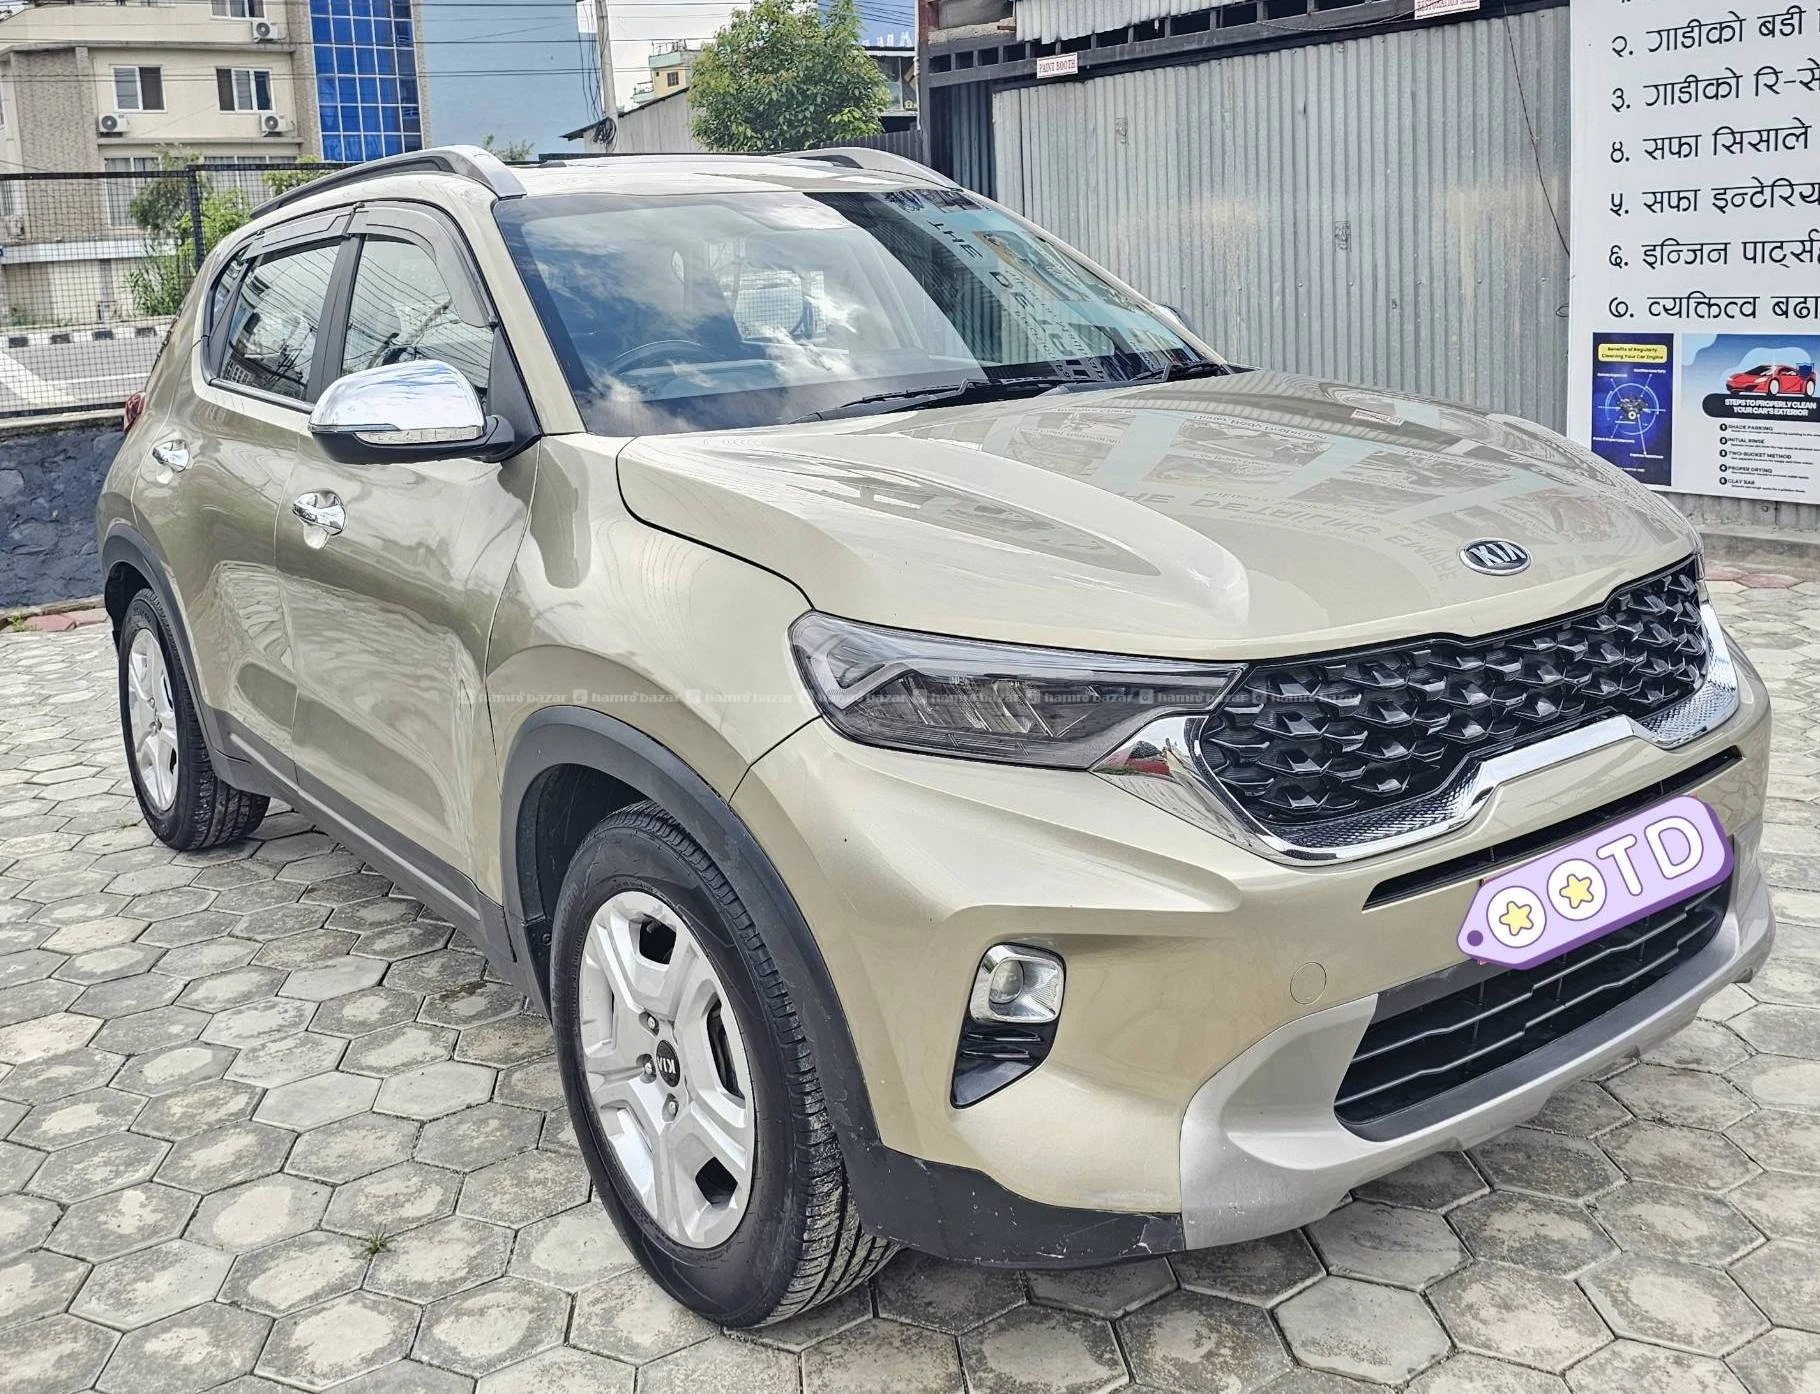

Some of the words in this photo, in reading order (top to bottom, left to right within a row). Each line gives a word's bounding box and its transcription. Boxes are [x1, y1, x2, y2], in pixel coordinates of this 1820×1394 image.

[1646, 11, 1746, 52] गाडीको
[1757, 5, 1806, 38] बडी
[1040, 62, 1055, 73] PAINT
[1056, 60, 1076, 70] BOOTH
[1643, 67, 1743, 106] गाडीको
[1643, 134, 1702, 160] सफा
[1712, 117, 1812, 156] सिसाले
[1642, 189, 1701, 213] सफा
[1642, 237, 1731, 269] इन्जिन
[1647, 291, 1760, 319] व्यक्तित्व
[1756, 400, 1791, 408] PROPERLY
[1792, 401, 1817, 409] CLEAN
[1773, 408, 1809, 416] EXTERIOR
[1468, 541, 1527, 567] KIA
[656, 1056, 677, 1074] KIA
